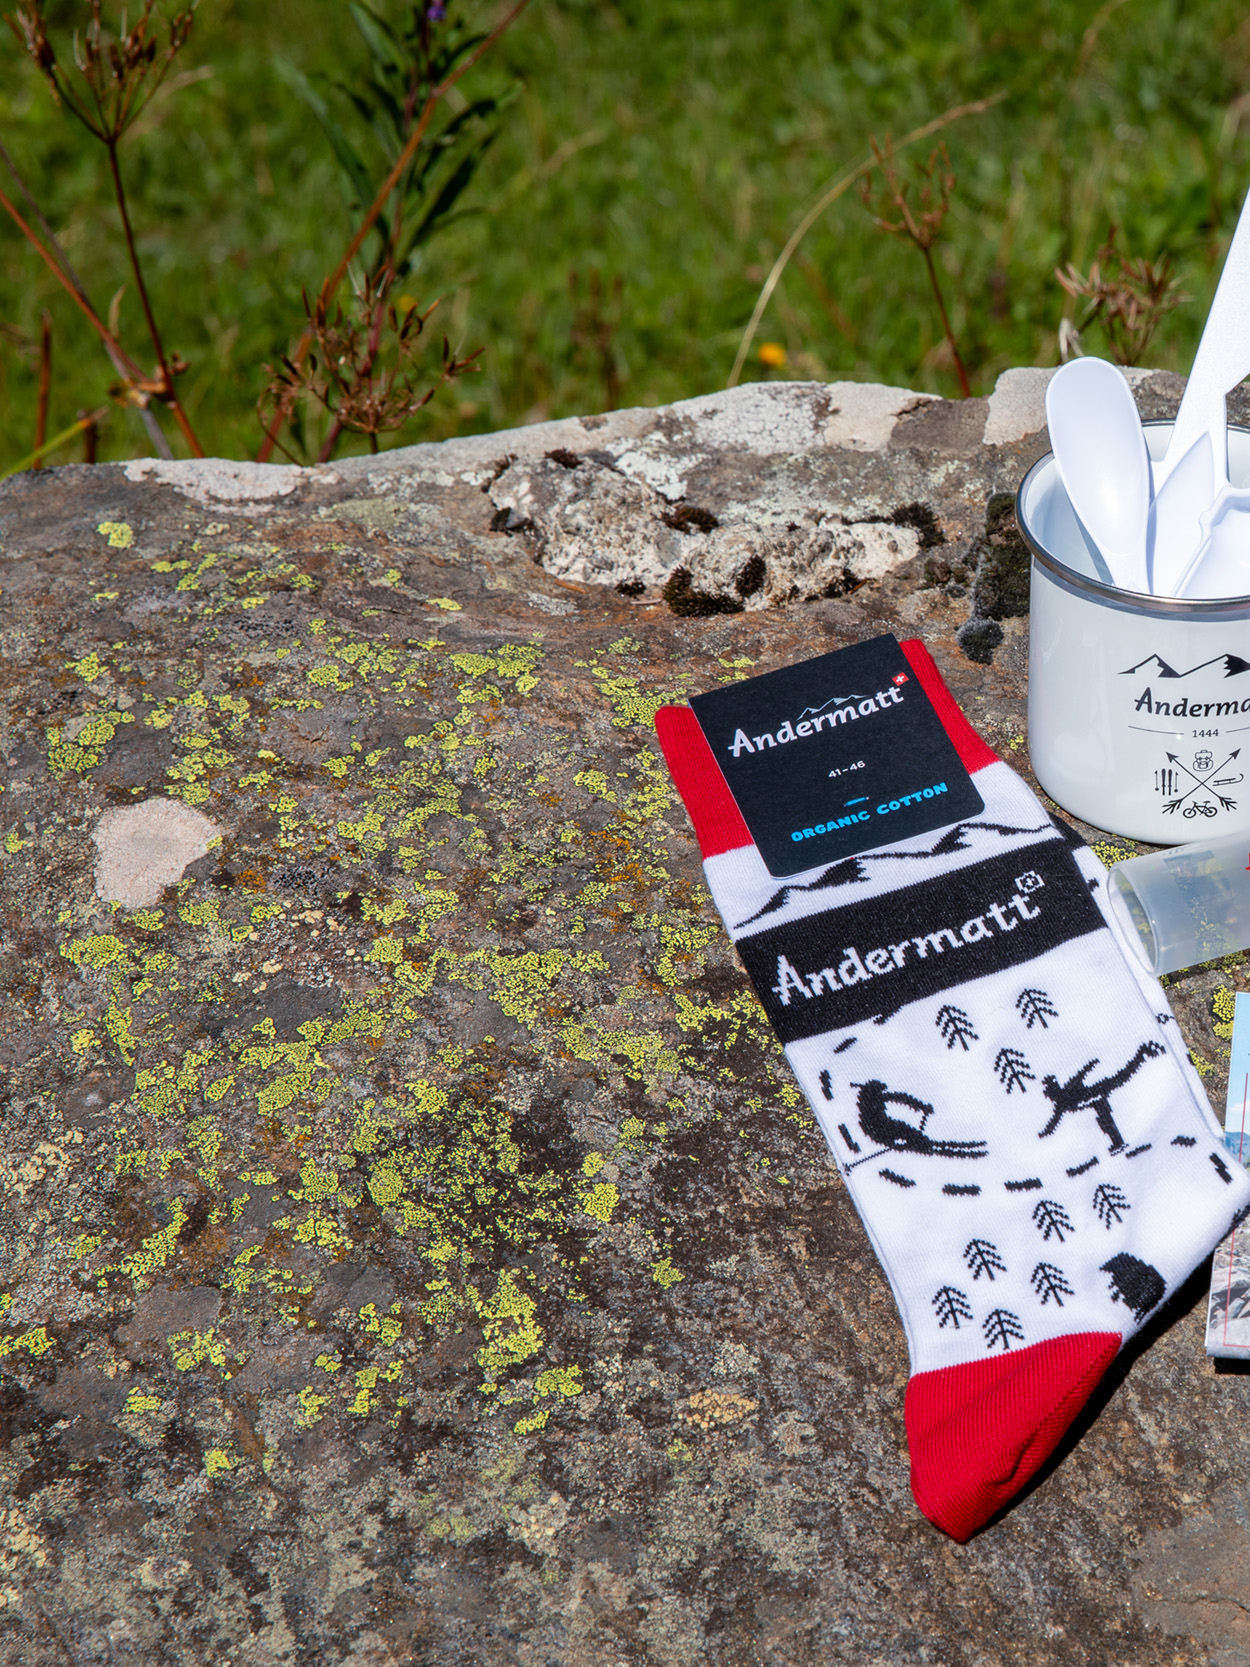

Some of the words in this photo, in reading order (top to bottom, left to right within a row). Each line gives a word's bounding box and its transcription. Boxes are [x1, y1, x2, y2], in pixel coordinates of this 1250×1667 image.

[727, 686, 905, 758] Andermatt
[1191, 728, 1220, 738] 1444
[828, 760, 866, 778] 41-46
[790, 810, 871, 842] ORGANIC
[876, 782, 949, 815] COTTON
[771, 892, 1041, 1007] Andermatt
